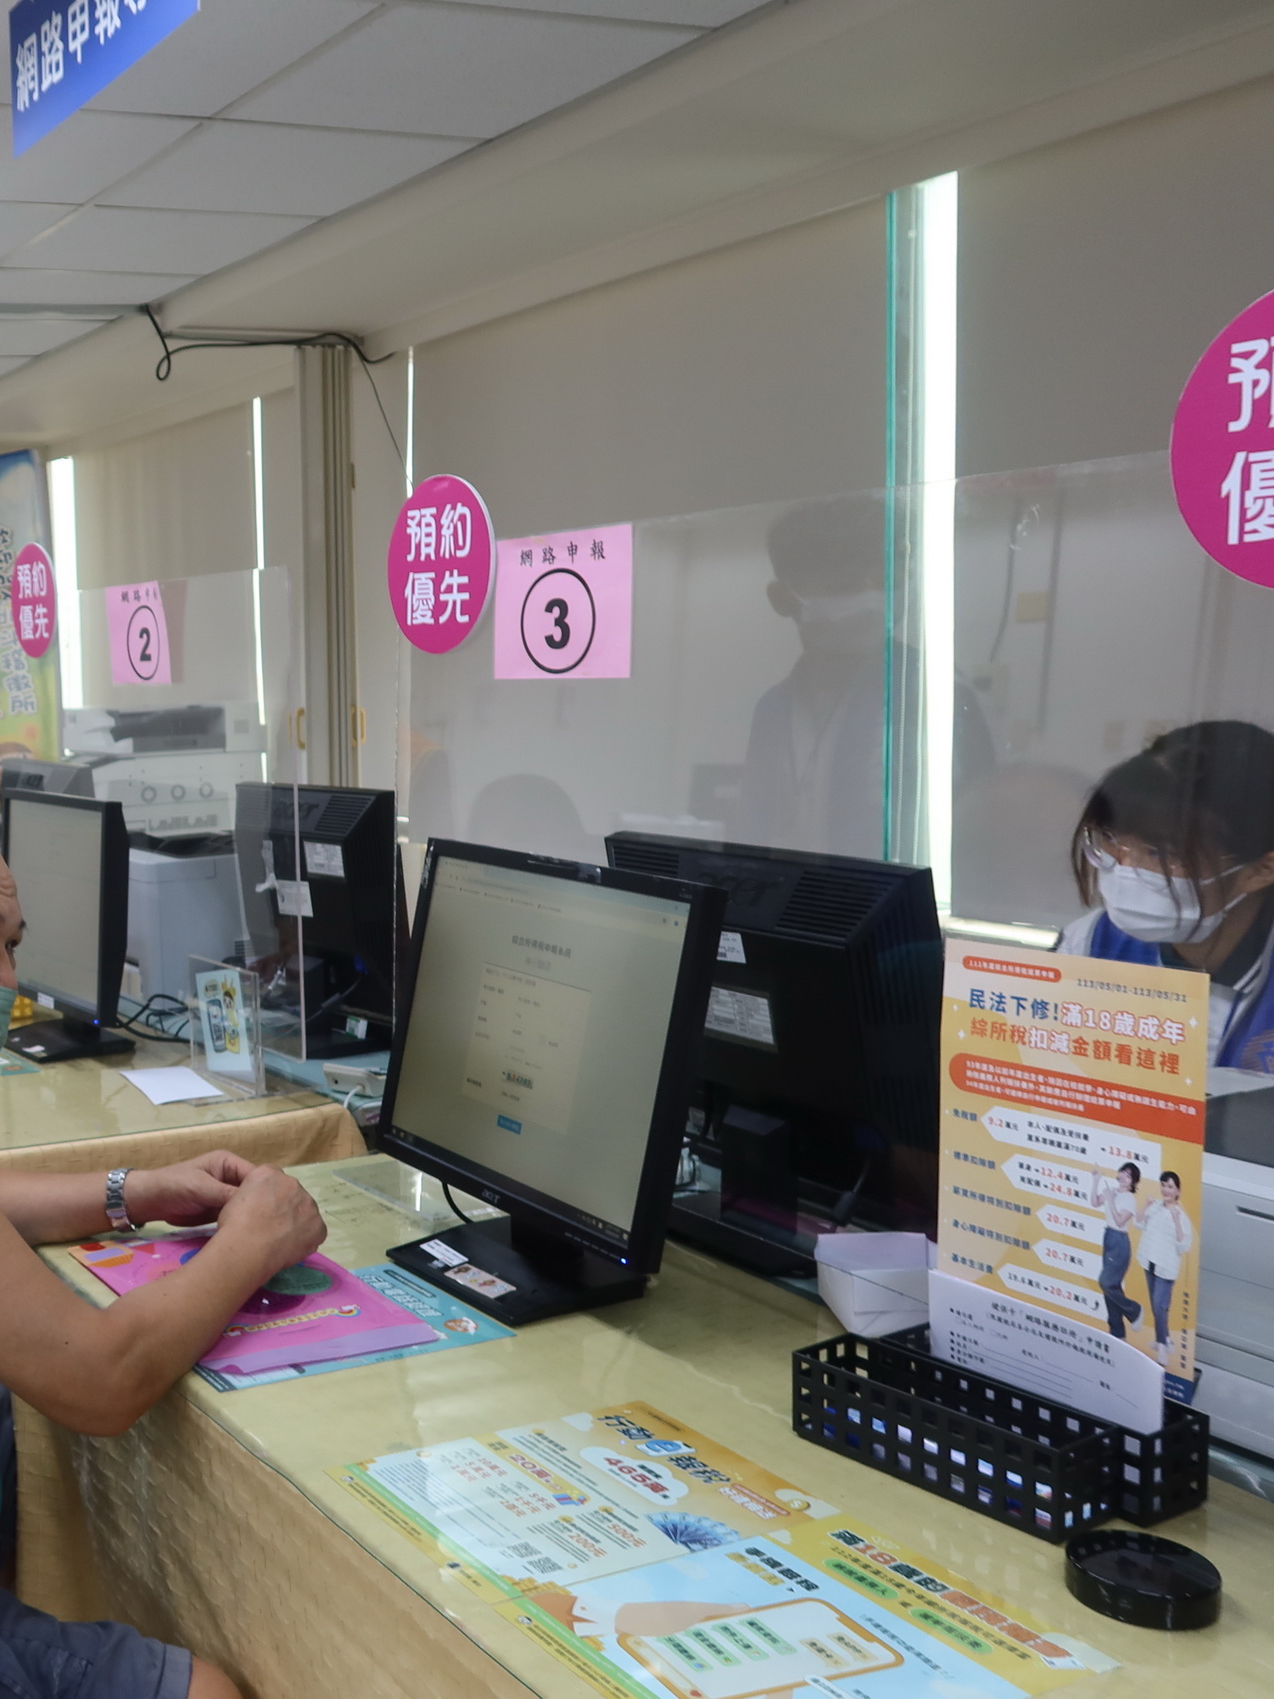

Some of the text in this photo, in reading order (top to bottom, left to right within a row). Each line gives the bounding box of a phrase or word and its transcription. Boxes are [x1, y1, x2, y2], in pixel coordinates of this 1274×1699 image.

[16, 0, 146, 112] 網路申報
[406, 502, 472, 562] 預約
[520, 539, 606, 568] 網路申報
[16, 561, 47, 600] 預約
[404, 569, 470, 626] 優先
[18, 603, 49, 641] 優先
[139, 627, 152, 661] 2
[544, 598, 571, 649] 3
[1077, 978, 1187, 1003] 113/05/01-113/05/31
[970, 1017, 1180, 1075] 綜所稅扣減金額看這裡
